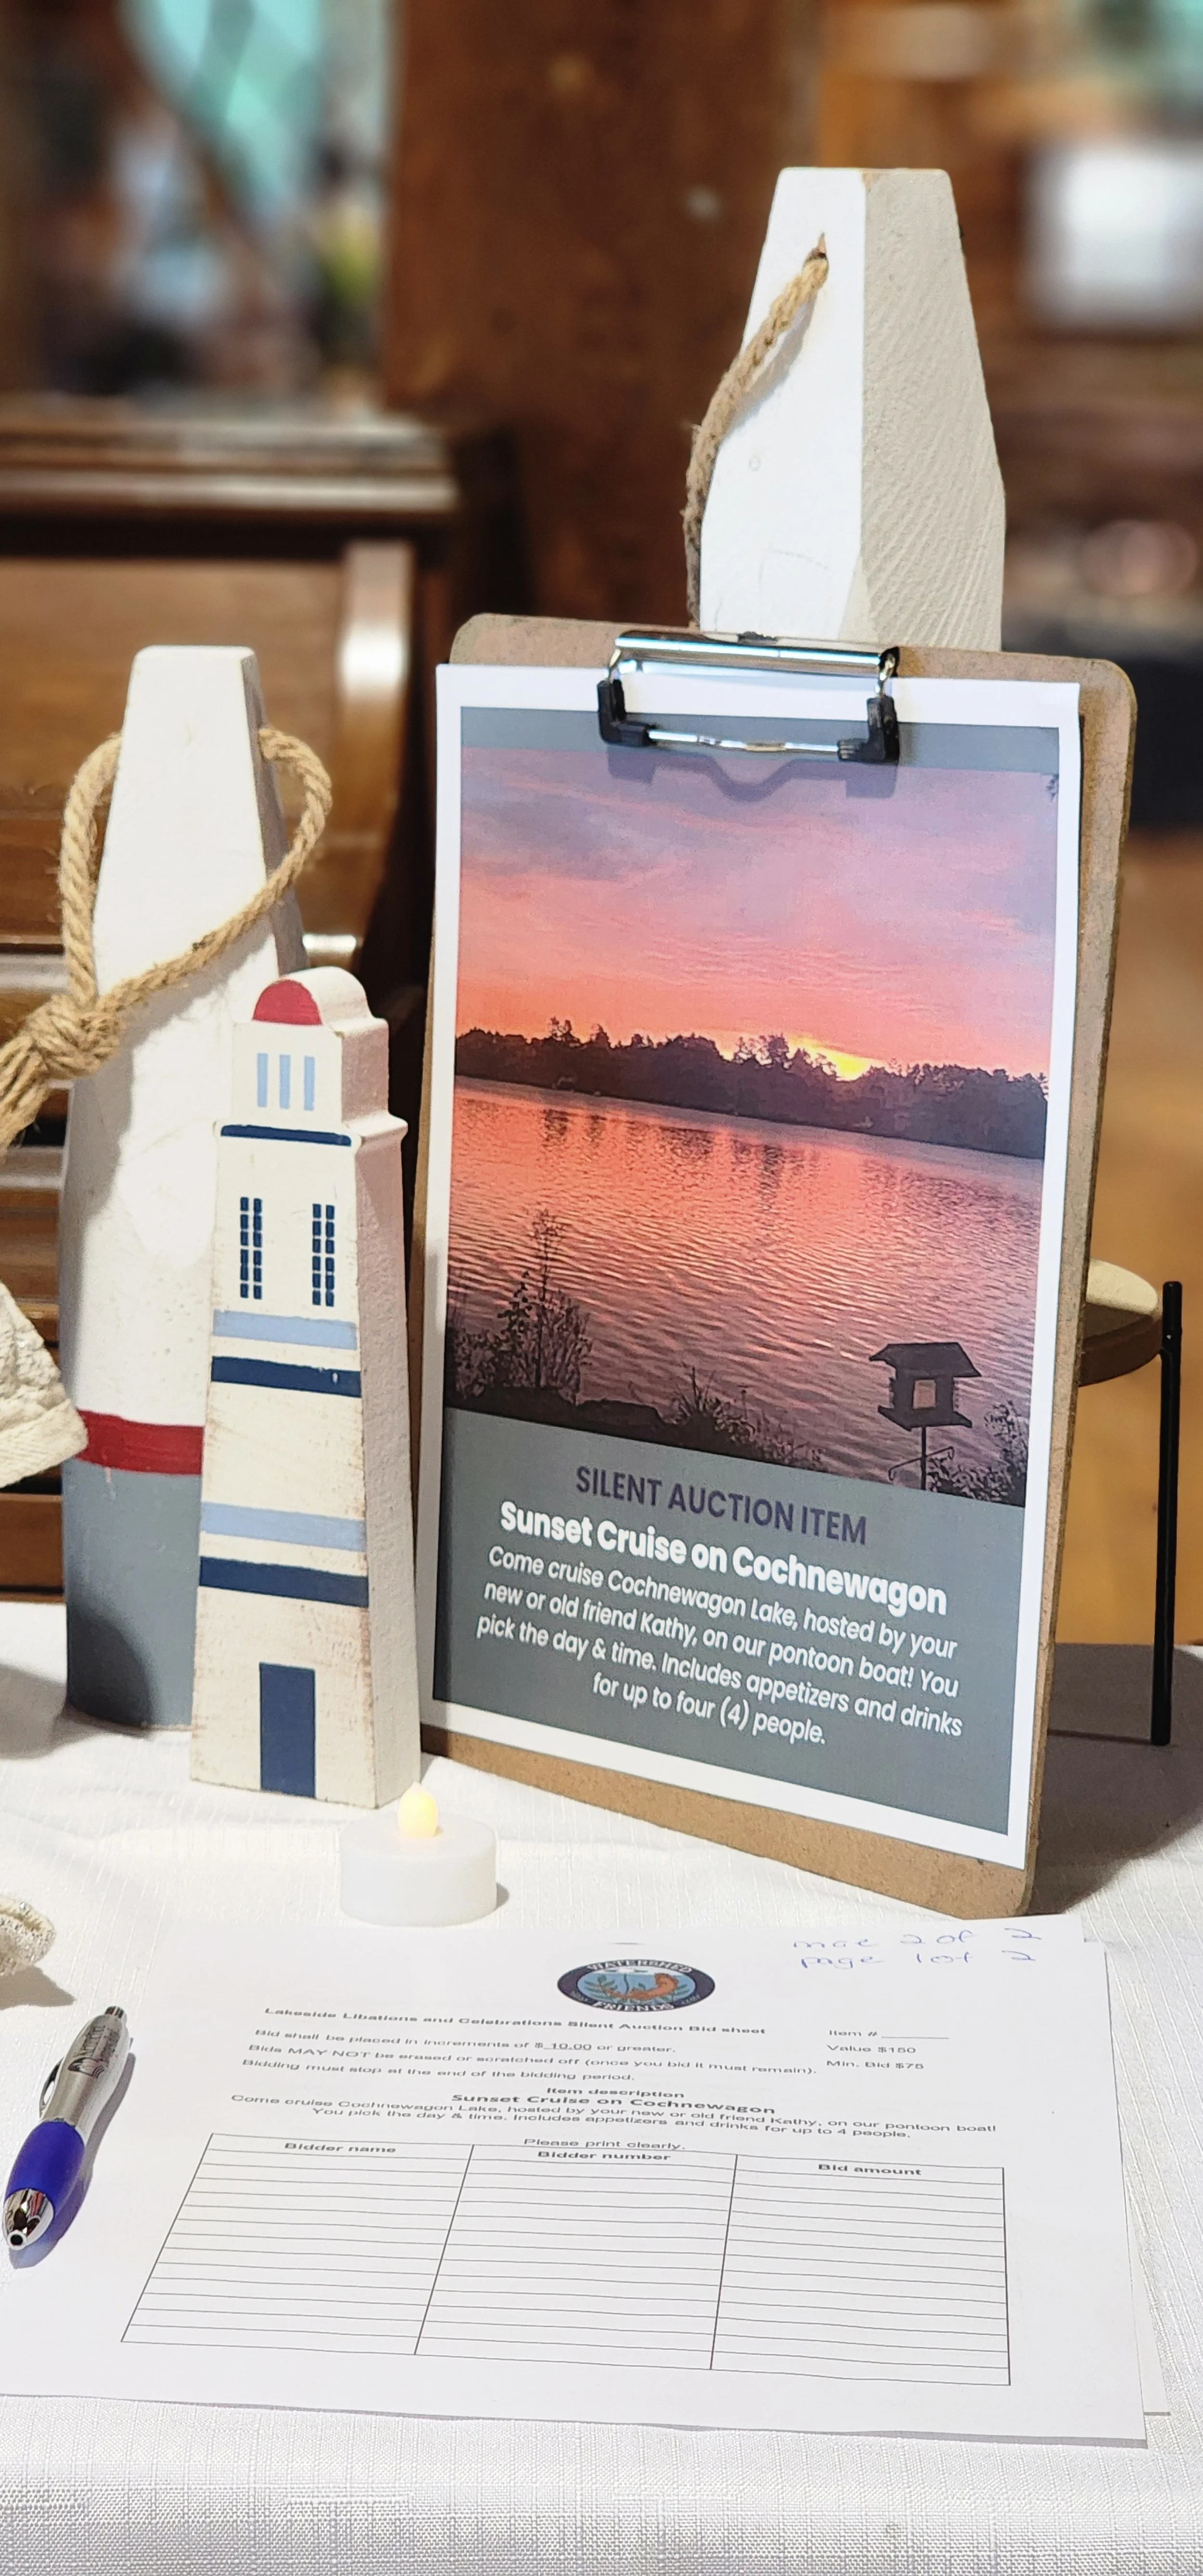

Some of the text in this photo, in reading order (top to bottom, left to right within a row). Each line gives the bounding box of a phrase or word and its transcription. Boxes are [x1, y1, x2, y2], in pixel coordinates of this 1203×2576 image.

[576, 1466, 866, 1545] SILENT AUCTION ITEM
[501, 1502, 947, 1617] Sunset Cruise on Cochnewagon
[489, 1546, 958, 1659] Come cruise Cochnewagon Lake, hosted by your
[485, 1583, 959, 1698] new or old friend Kathy, on our pontoon boat! You
[477, 1614, 962, 1736] pick the day & time. Includes appetizers and drinks
[593, 1672, 825, 1744] for up to four (4) people.
[900, 1934, 925, 1944] 2
[1004, 1928, 1042, 1940] 2
[587, 1960, 692, 1973] WATERSHED
[801, 1956, 885, 1969] page
[1001, 1950, 1036, 1961] 2
[265, 2008, 336, 2017] Lakeside
[343, 2013, 417, 2021] Libations
[592, 2001, 674, 2012] FRIENDS
[249, 2044, 282, 2052] Bids
[243, 2059, 300, 2070] Bidding
[521, 2071, 576, 2079] bidding
[589, 2089, 684, 2098] description
[231, 2095, 280, 2103] Come
[338, 2102, 452, 2111] Cochnewagon
[720, 2114, 765, 2123] friend
[630, 2099, 775, 2114] Cochnewagon
[710, 2122, 758, 2130] drinks
[284, 2143, 344, 2152] Bidder
